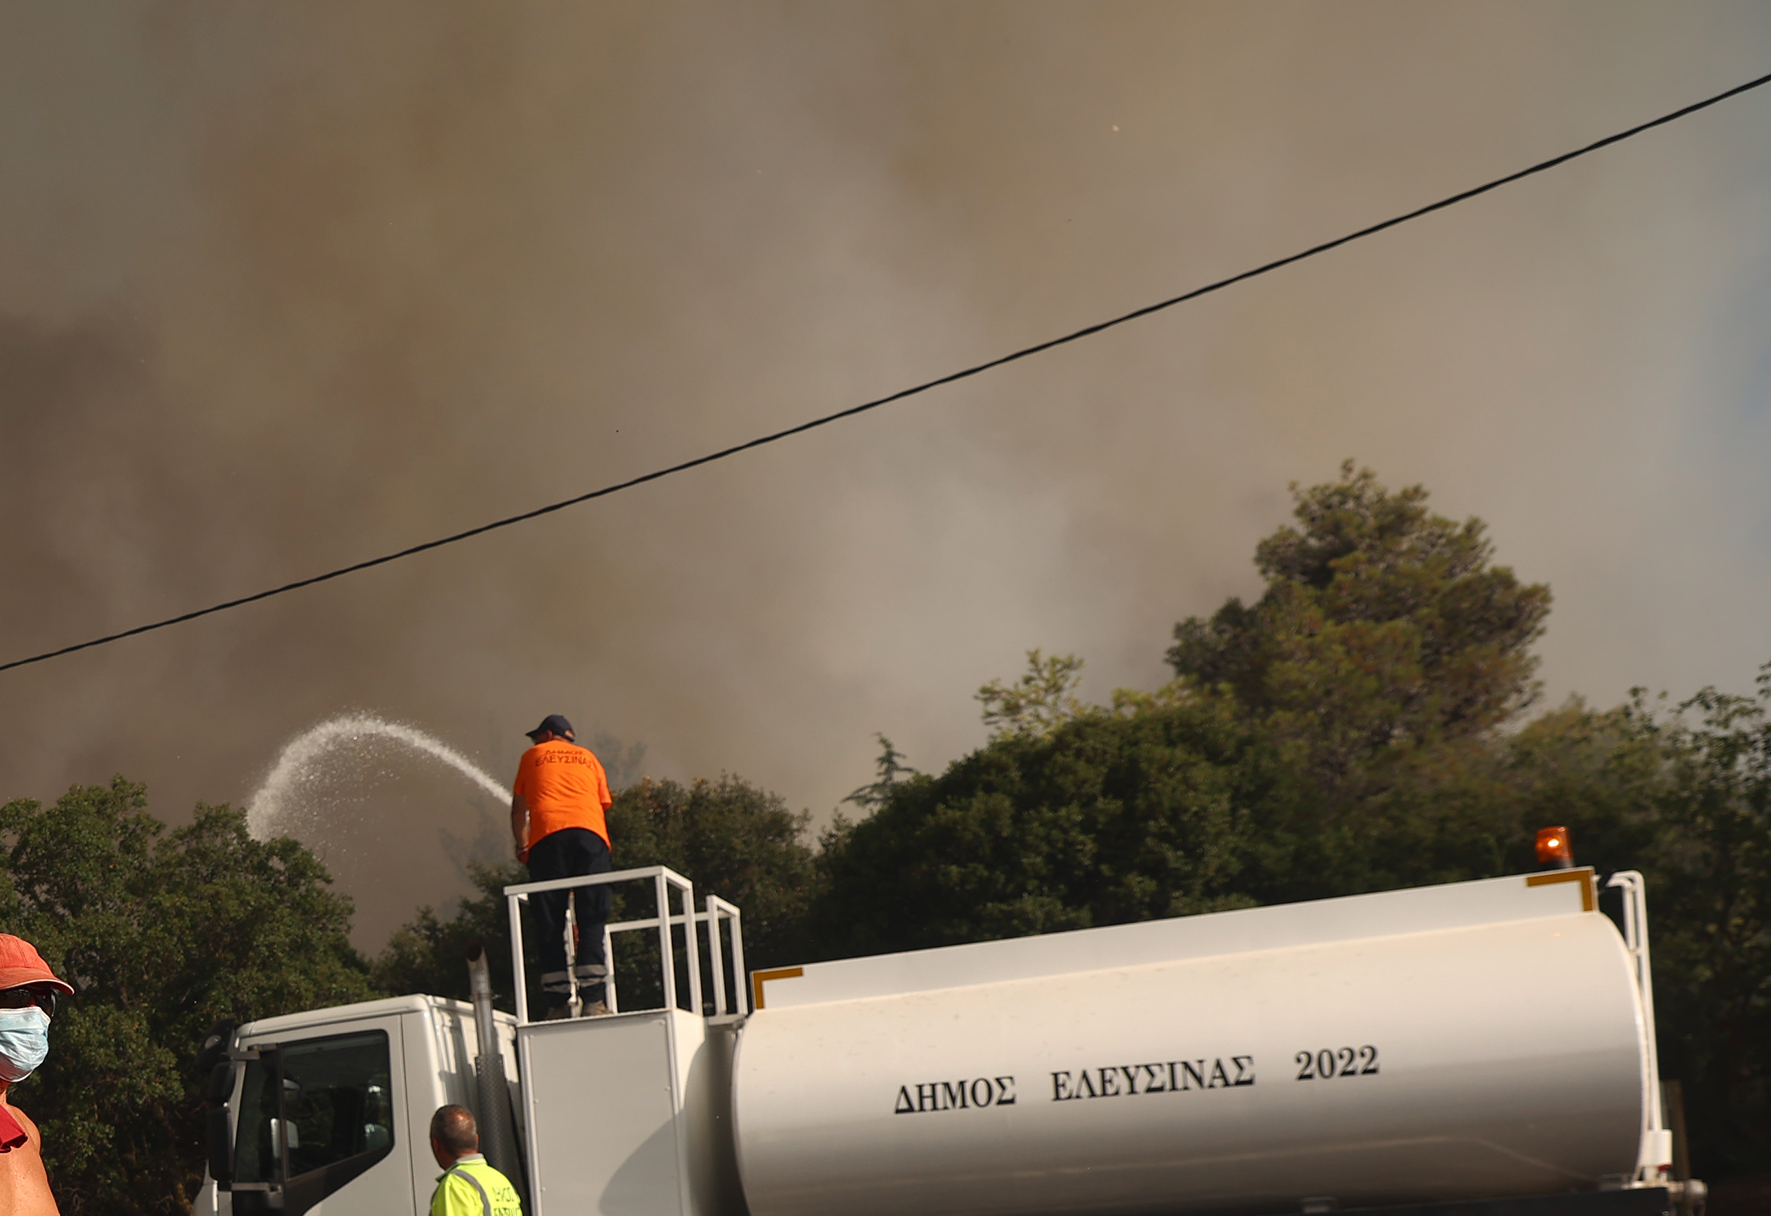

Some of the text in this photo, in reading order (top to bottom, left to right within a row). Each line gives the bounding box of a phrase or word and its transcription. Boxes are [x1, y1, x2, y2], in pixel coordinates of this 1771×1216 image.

[893, 1044, 1380, 1115] ΔΗΜΟΣ ΕΛΕΥΣΙΝΑΣ 2022
